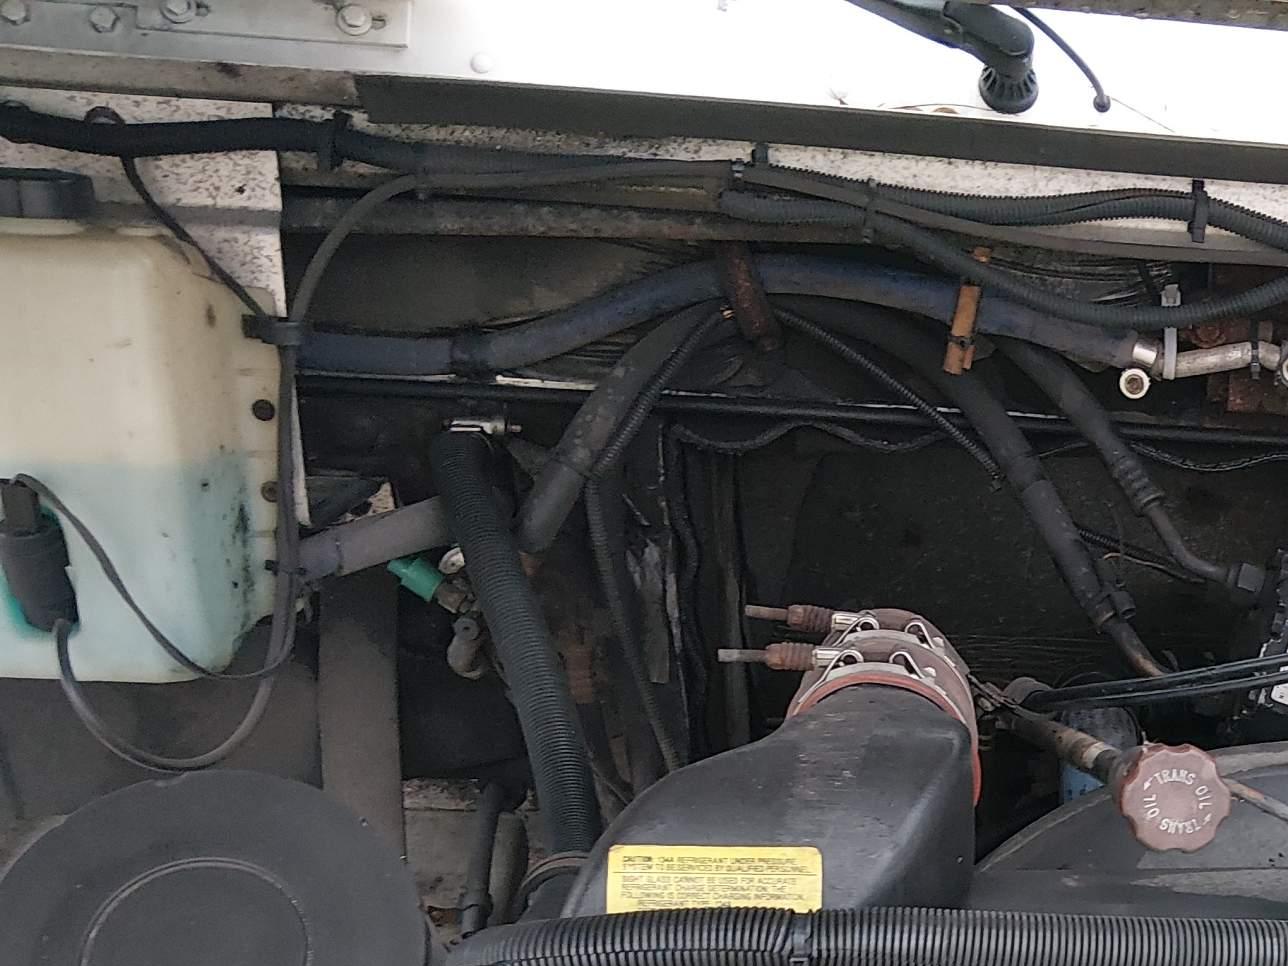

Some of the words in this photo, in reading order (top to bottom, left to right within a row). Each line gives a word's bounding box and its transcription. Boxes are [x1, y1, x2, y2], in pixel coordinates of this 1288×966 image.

[1155, 769, 1196, 785] TRANS
[1194, 785, 1214, 810] OIL
[1142, 793, 1161, 819] OIL
[1159, 817, 1202, 835] TRANS
